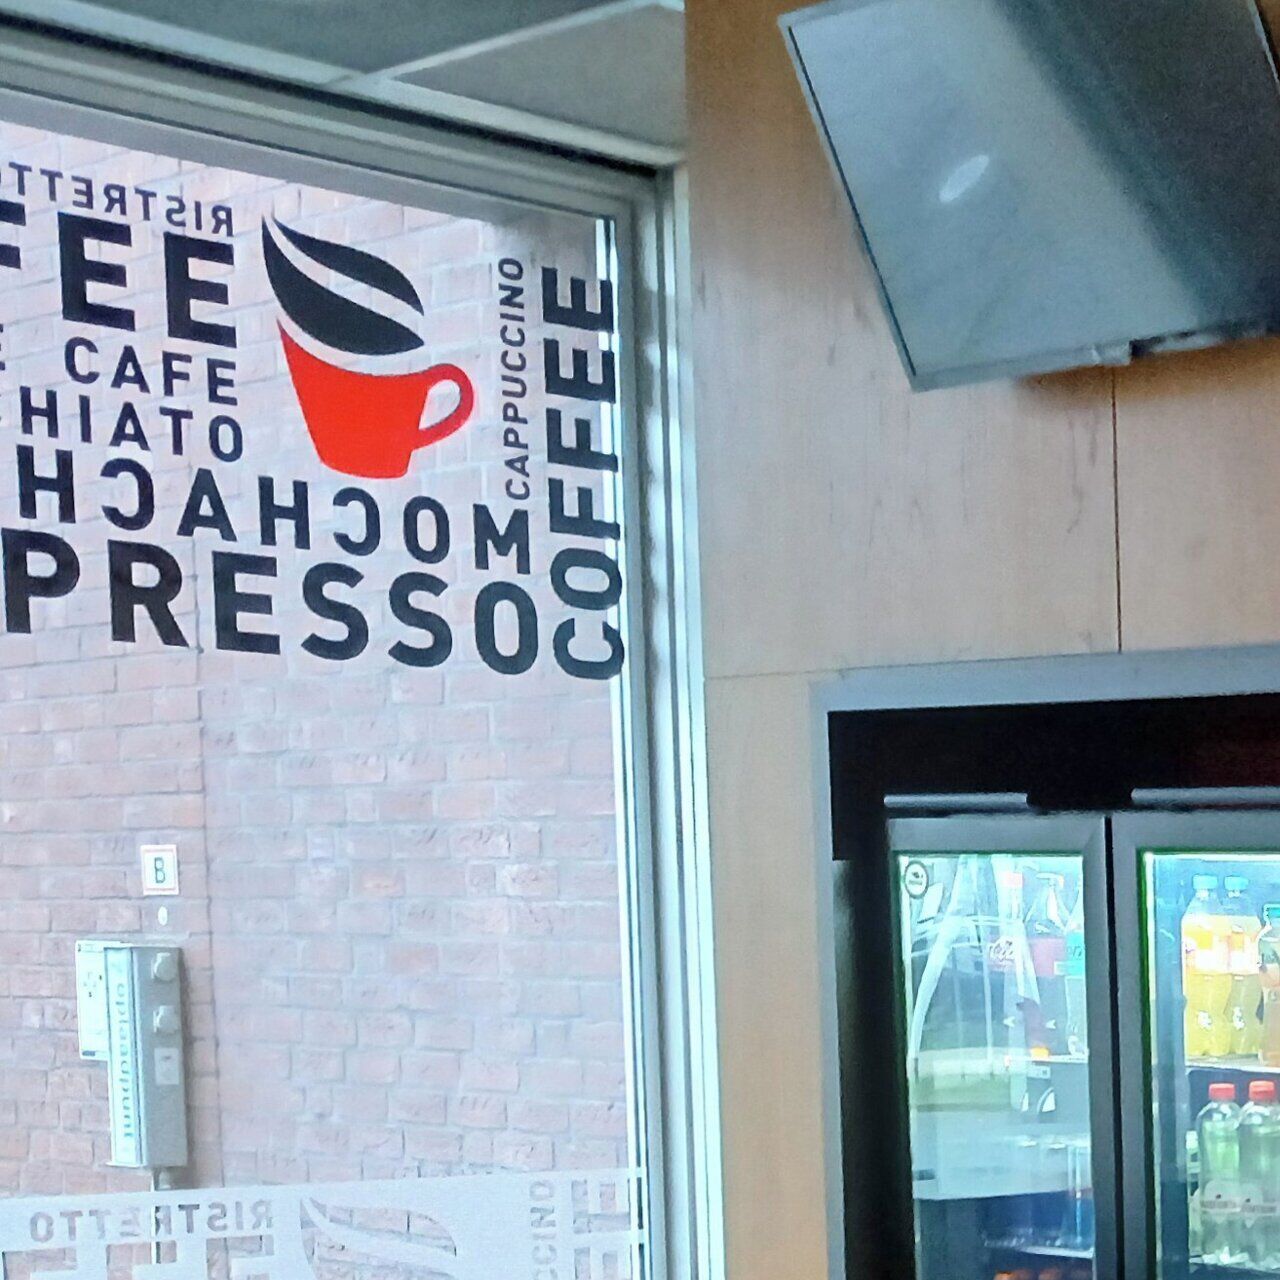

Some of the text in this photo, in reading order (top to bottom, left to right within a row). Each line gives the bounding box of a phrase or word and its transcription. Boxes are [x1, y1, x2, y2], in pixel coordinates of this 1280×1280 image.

[64, 336, 239, 406] CAFE
[498, 257, 530, 501] CAPPUCCINO
[541, 266, 626, 681] COFFEE
